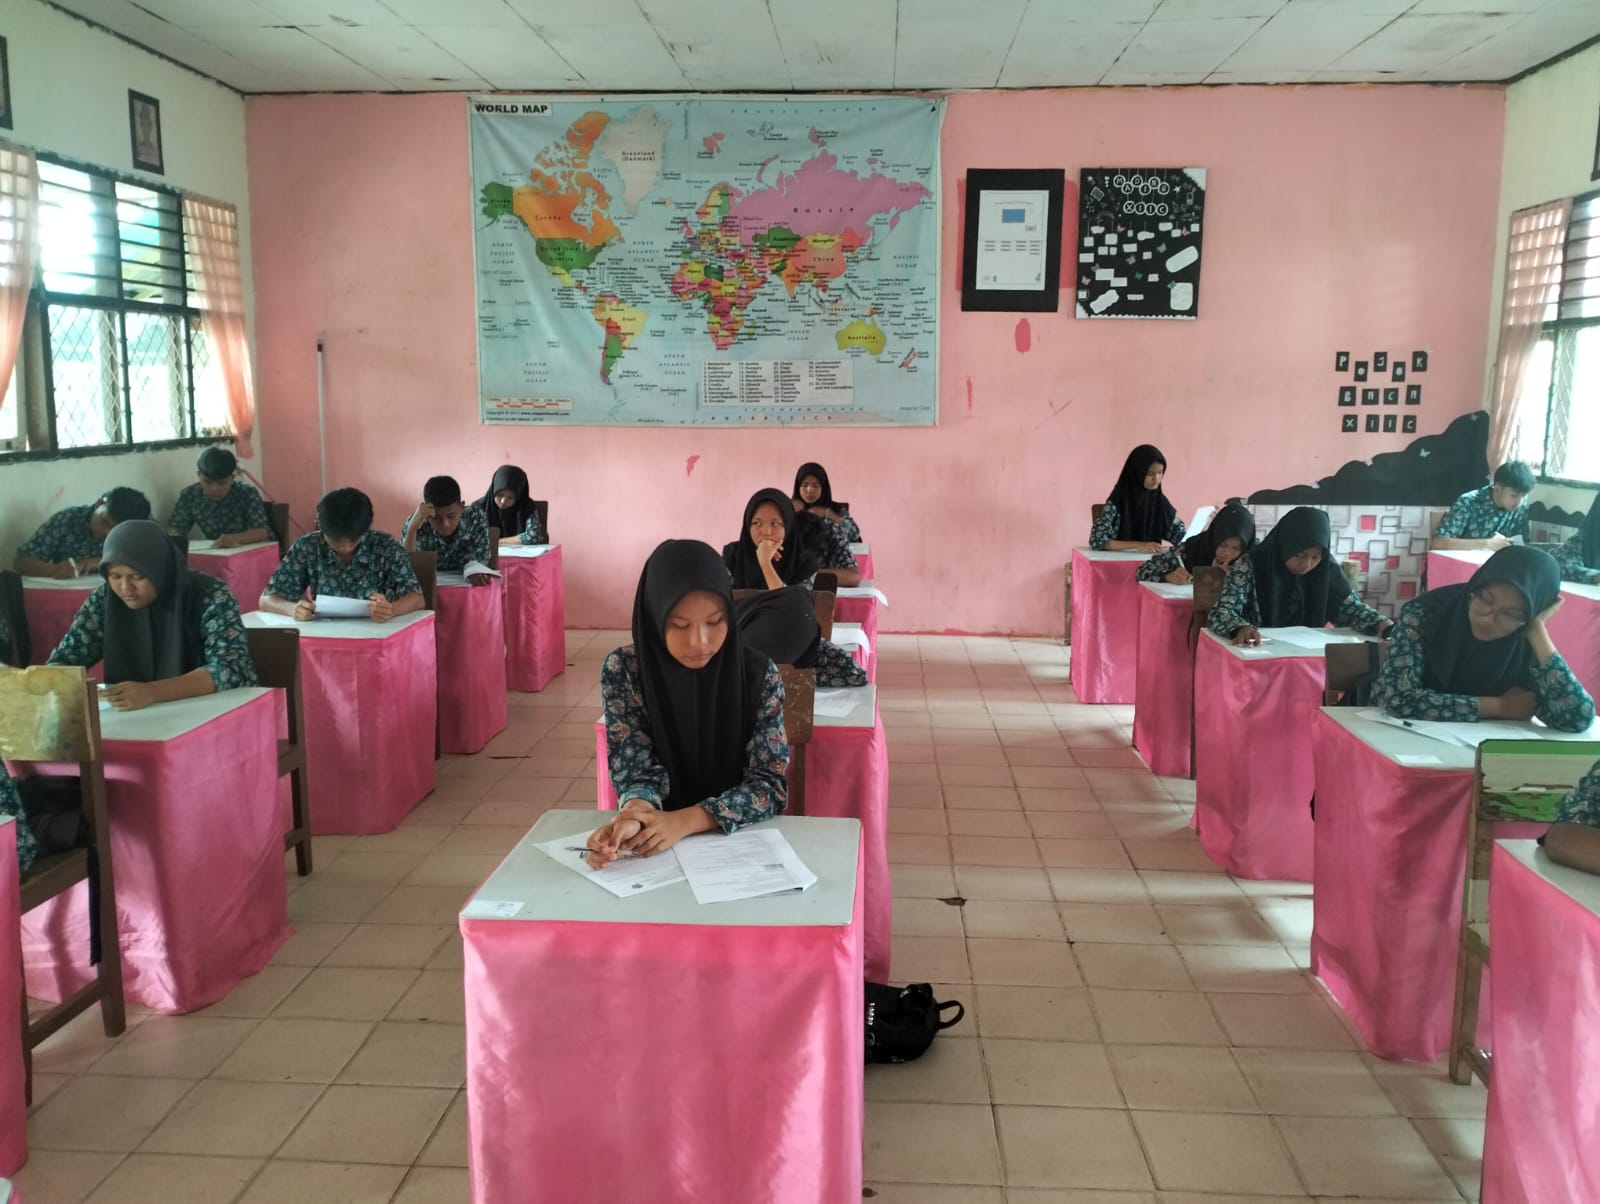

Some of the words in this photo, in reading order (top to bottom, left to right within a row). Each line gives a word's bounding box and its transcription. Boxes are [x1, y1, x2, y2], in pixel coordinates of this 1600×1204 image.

[475, 104, 519, 113] WORLD
[522, 104, 548, 114] MAP
[1341, 388, 1419, 403] BACA
